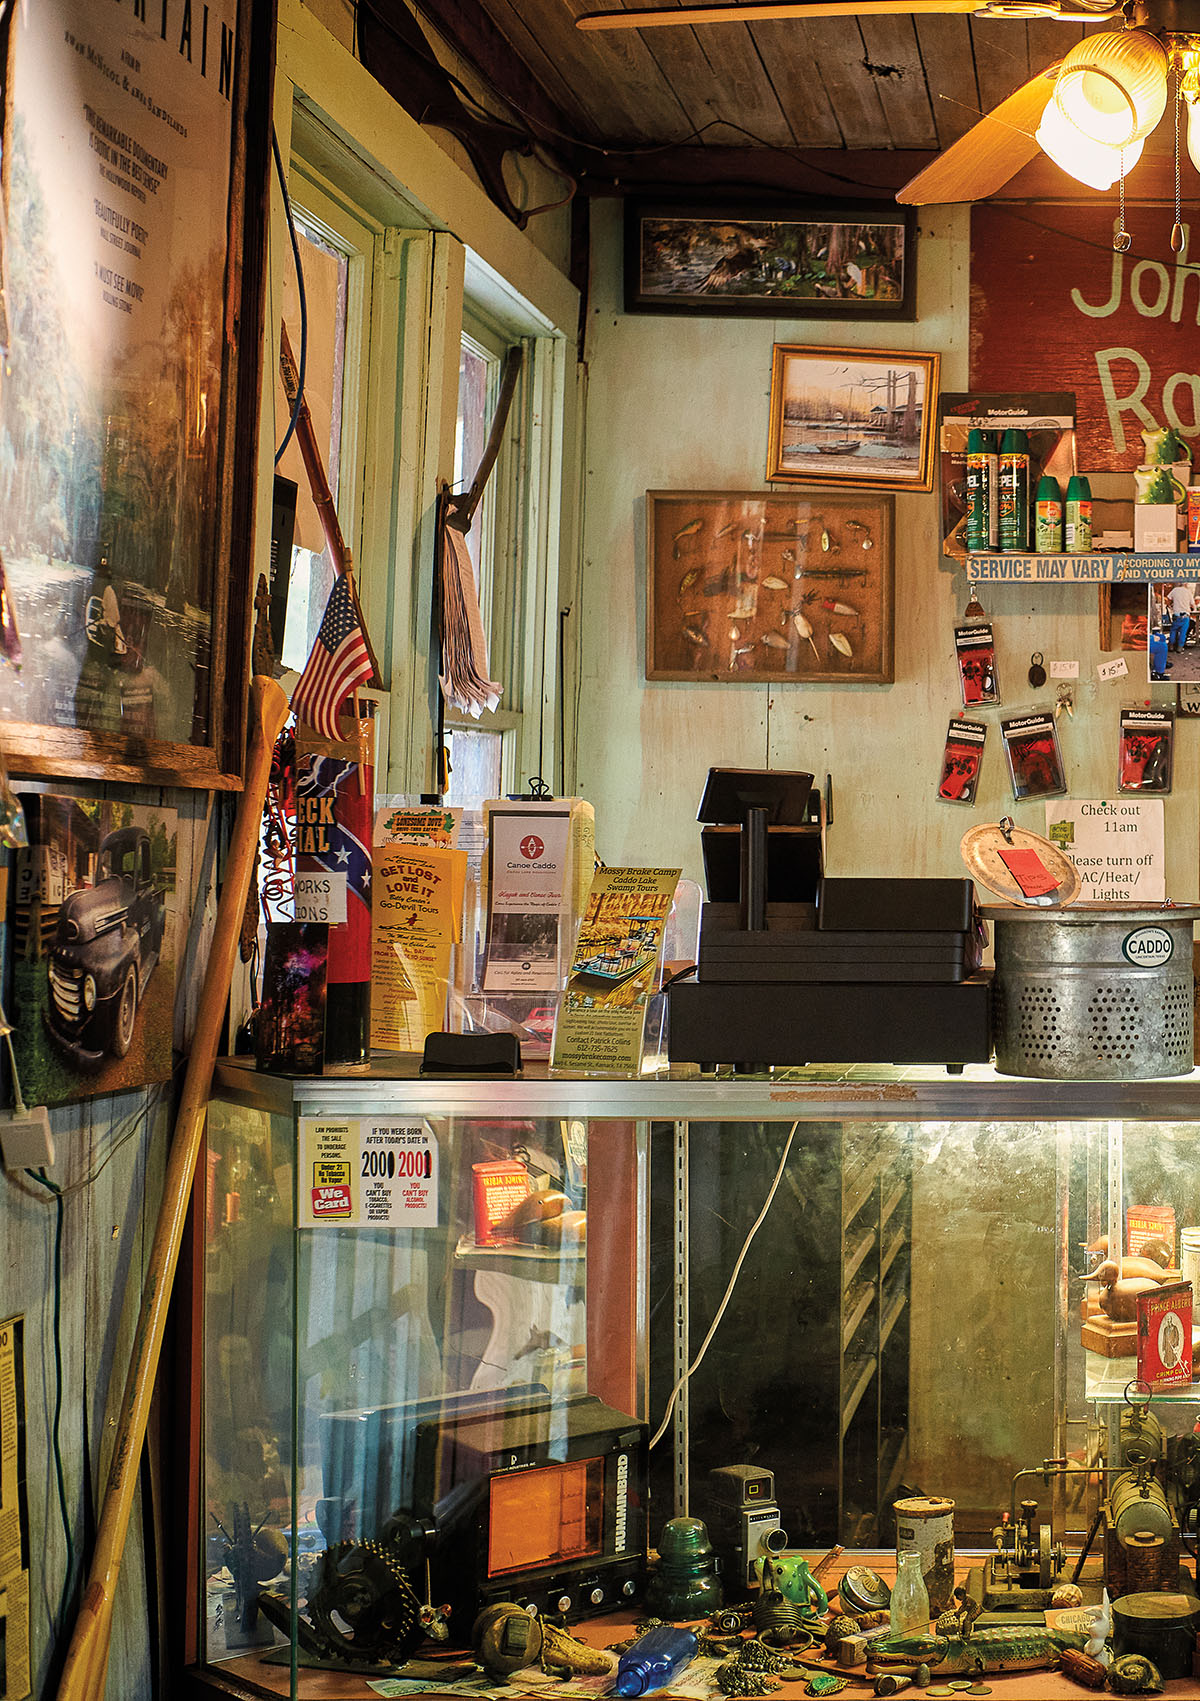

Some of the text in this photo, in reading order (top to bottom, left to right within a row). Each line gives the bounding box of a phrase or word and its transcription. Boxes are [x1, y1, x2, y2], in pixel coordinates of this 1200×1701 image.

[113, 273, 125, 293] SEE
[987, 408, 1029, 416] MotorGuide
[970, 558, 1032, 579] SERVICE
[1035, 558, 1069, 578] MAY
[1070, 558, 1110, 579] VARY
[1117, 557, 1170, 568] ACCORDING
[1171, 558, 1184, 568] TO
[1186, 558, 1200, 568] MY
[1116, 568, 1137, 579] AND
[1140, 568, 1172, 579] YOUR
[957, 628, 989, 637] MotorGuide
[1129, 711, 1165, 720] MotorGuide
[1009, 716, 1045, 728] MotorGuide
[953, 723, 984, 733] MotorGuide
[1080, 803, 1140, 816] Check out
[1103, 822, 1138, 833] 11am
[506, 861, 531, 869] Canoe
[1106, 856, 1132, 867] turn
[1134, 854, 1153, 867] off
[380, 865, 442, 885] GET LOST
[599, 868, 678, 877] Mossy Brake Camp
[1081, 870, 1140, 884] AC/Heat/
[386, 882, 435, 898] LOVE IT
[606, 884, 636, 892] Swamp
[1092, 887, 1130, 901] Lights
[379, 900, 439, 914] Go-Devil Tours
[1128, 939, 1171, 955] CADDO
[590, 1036, 611, 1044] Patrick
[611, 1037, 632, 1045] Collins
[576, 1044, 619, 1053] 612-735-7625
[561, 1053, 632, 1062] mossybrakecamp.com
[390, 1127, 406, 1135] WERE
[406, 1127, 422, 1135] BORN
[366, 1136, 429, 1144] AFTER TODAY'S DATE IN
[361, 1150, 395, 1179] 200
[319, 1188, 344, 1199] We
[365, 1189, 392, 1197] CAN'T BUY
[402, 1189, 429, 1197] CAN'T BUY
[313, 1197, 350, 1210] Card
[1150, 1301, 1170, 1315] PRINCE
[614, 1454, 629, 1553] HUMMINBIRD
